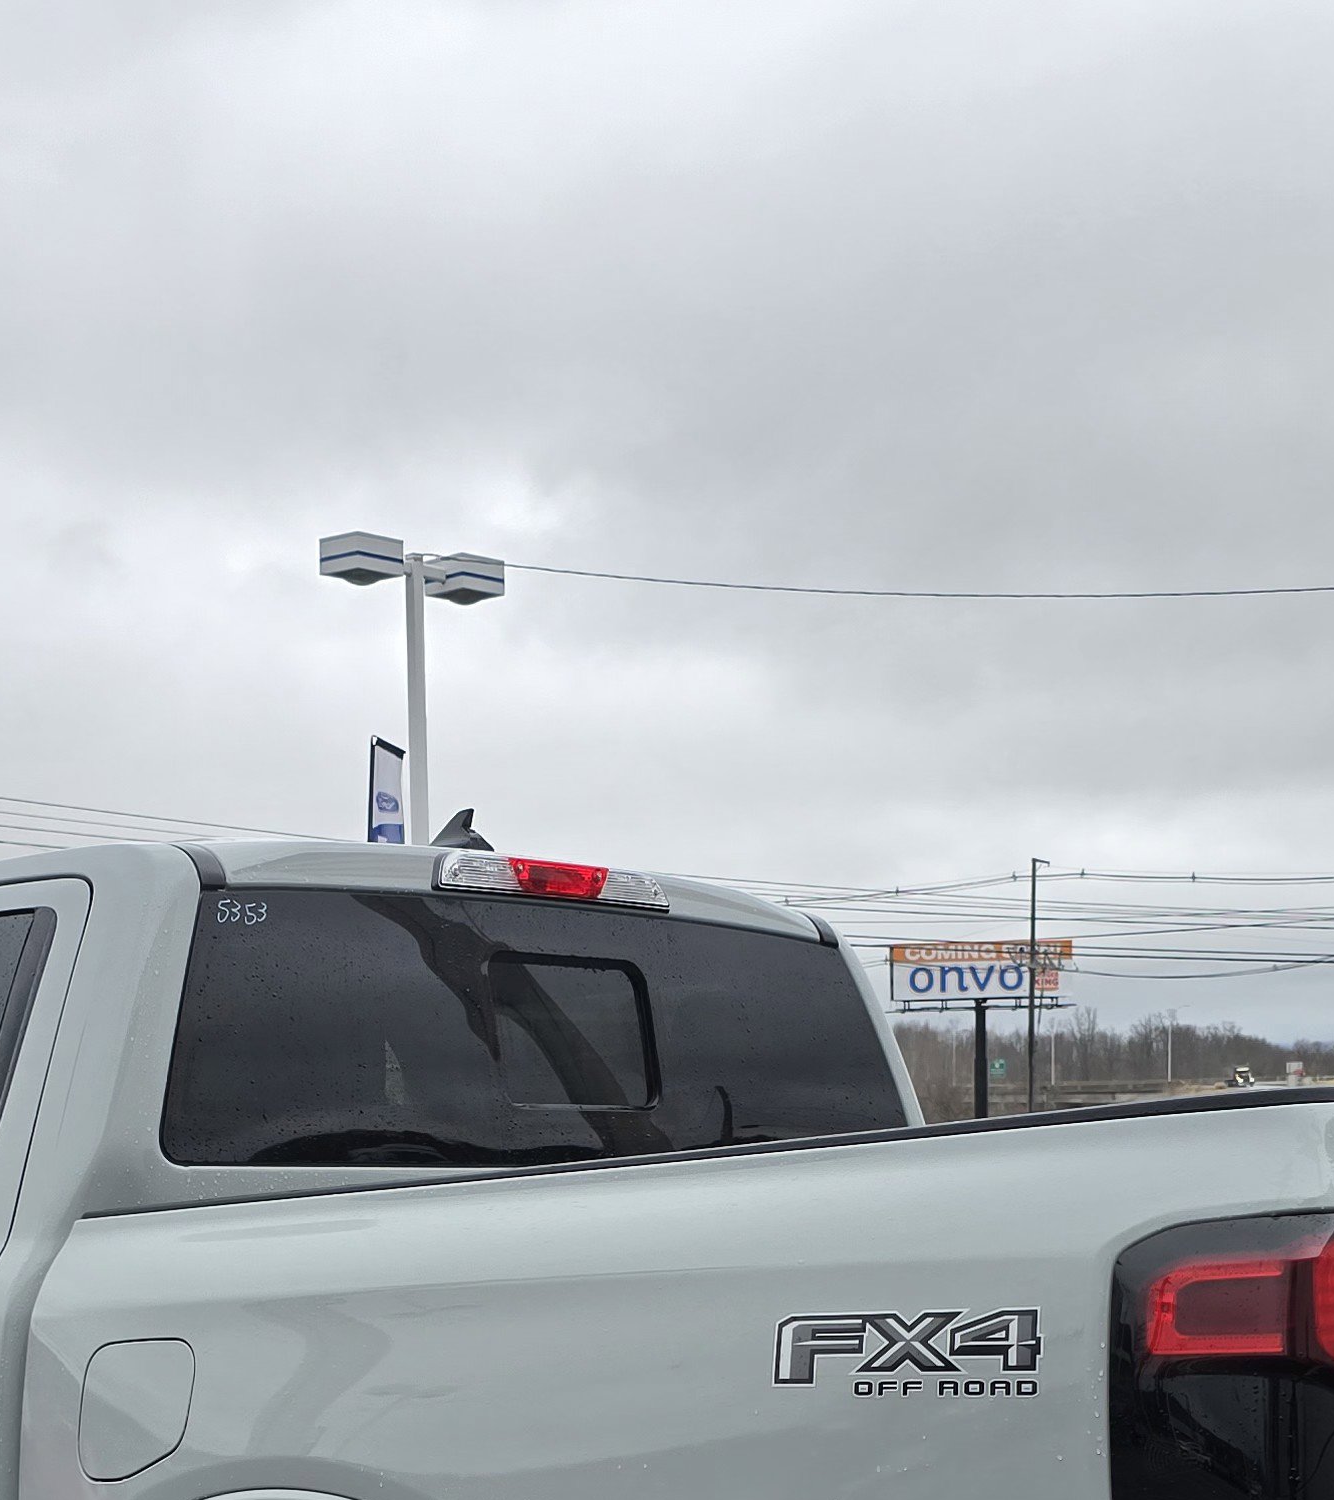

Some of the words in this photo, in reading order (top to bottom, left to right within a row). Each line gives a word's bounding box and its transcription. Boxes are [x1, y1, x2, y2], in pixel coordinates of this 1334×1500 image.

[217, 899, 267, 925] 5353
[905, 944, 997, 961] COMING
[909, 964, 1024, 994] onvo
[772, 1306, 1045, 1388] FX4
[853, 1378, 923, 1398] OFF
[937, 1378, 1041, 1398] ROAD
